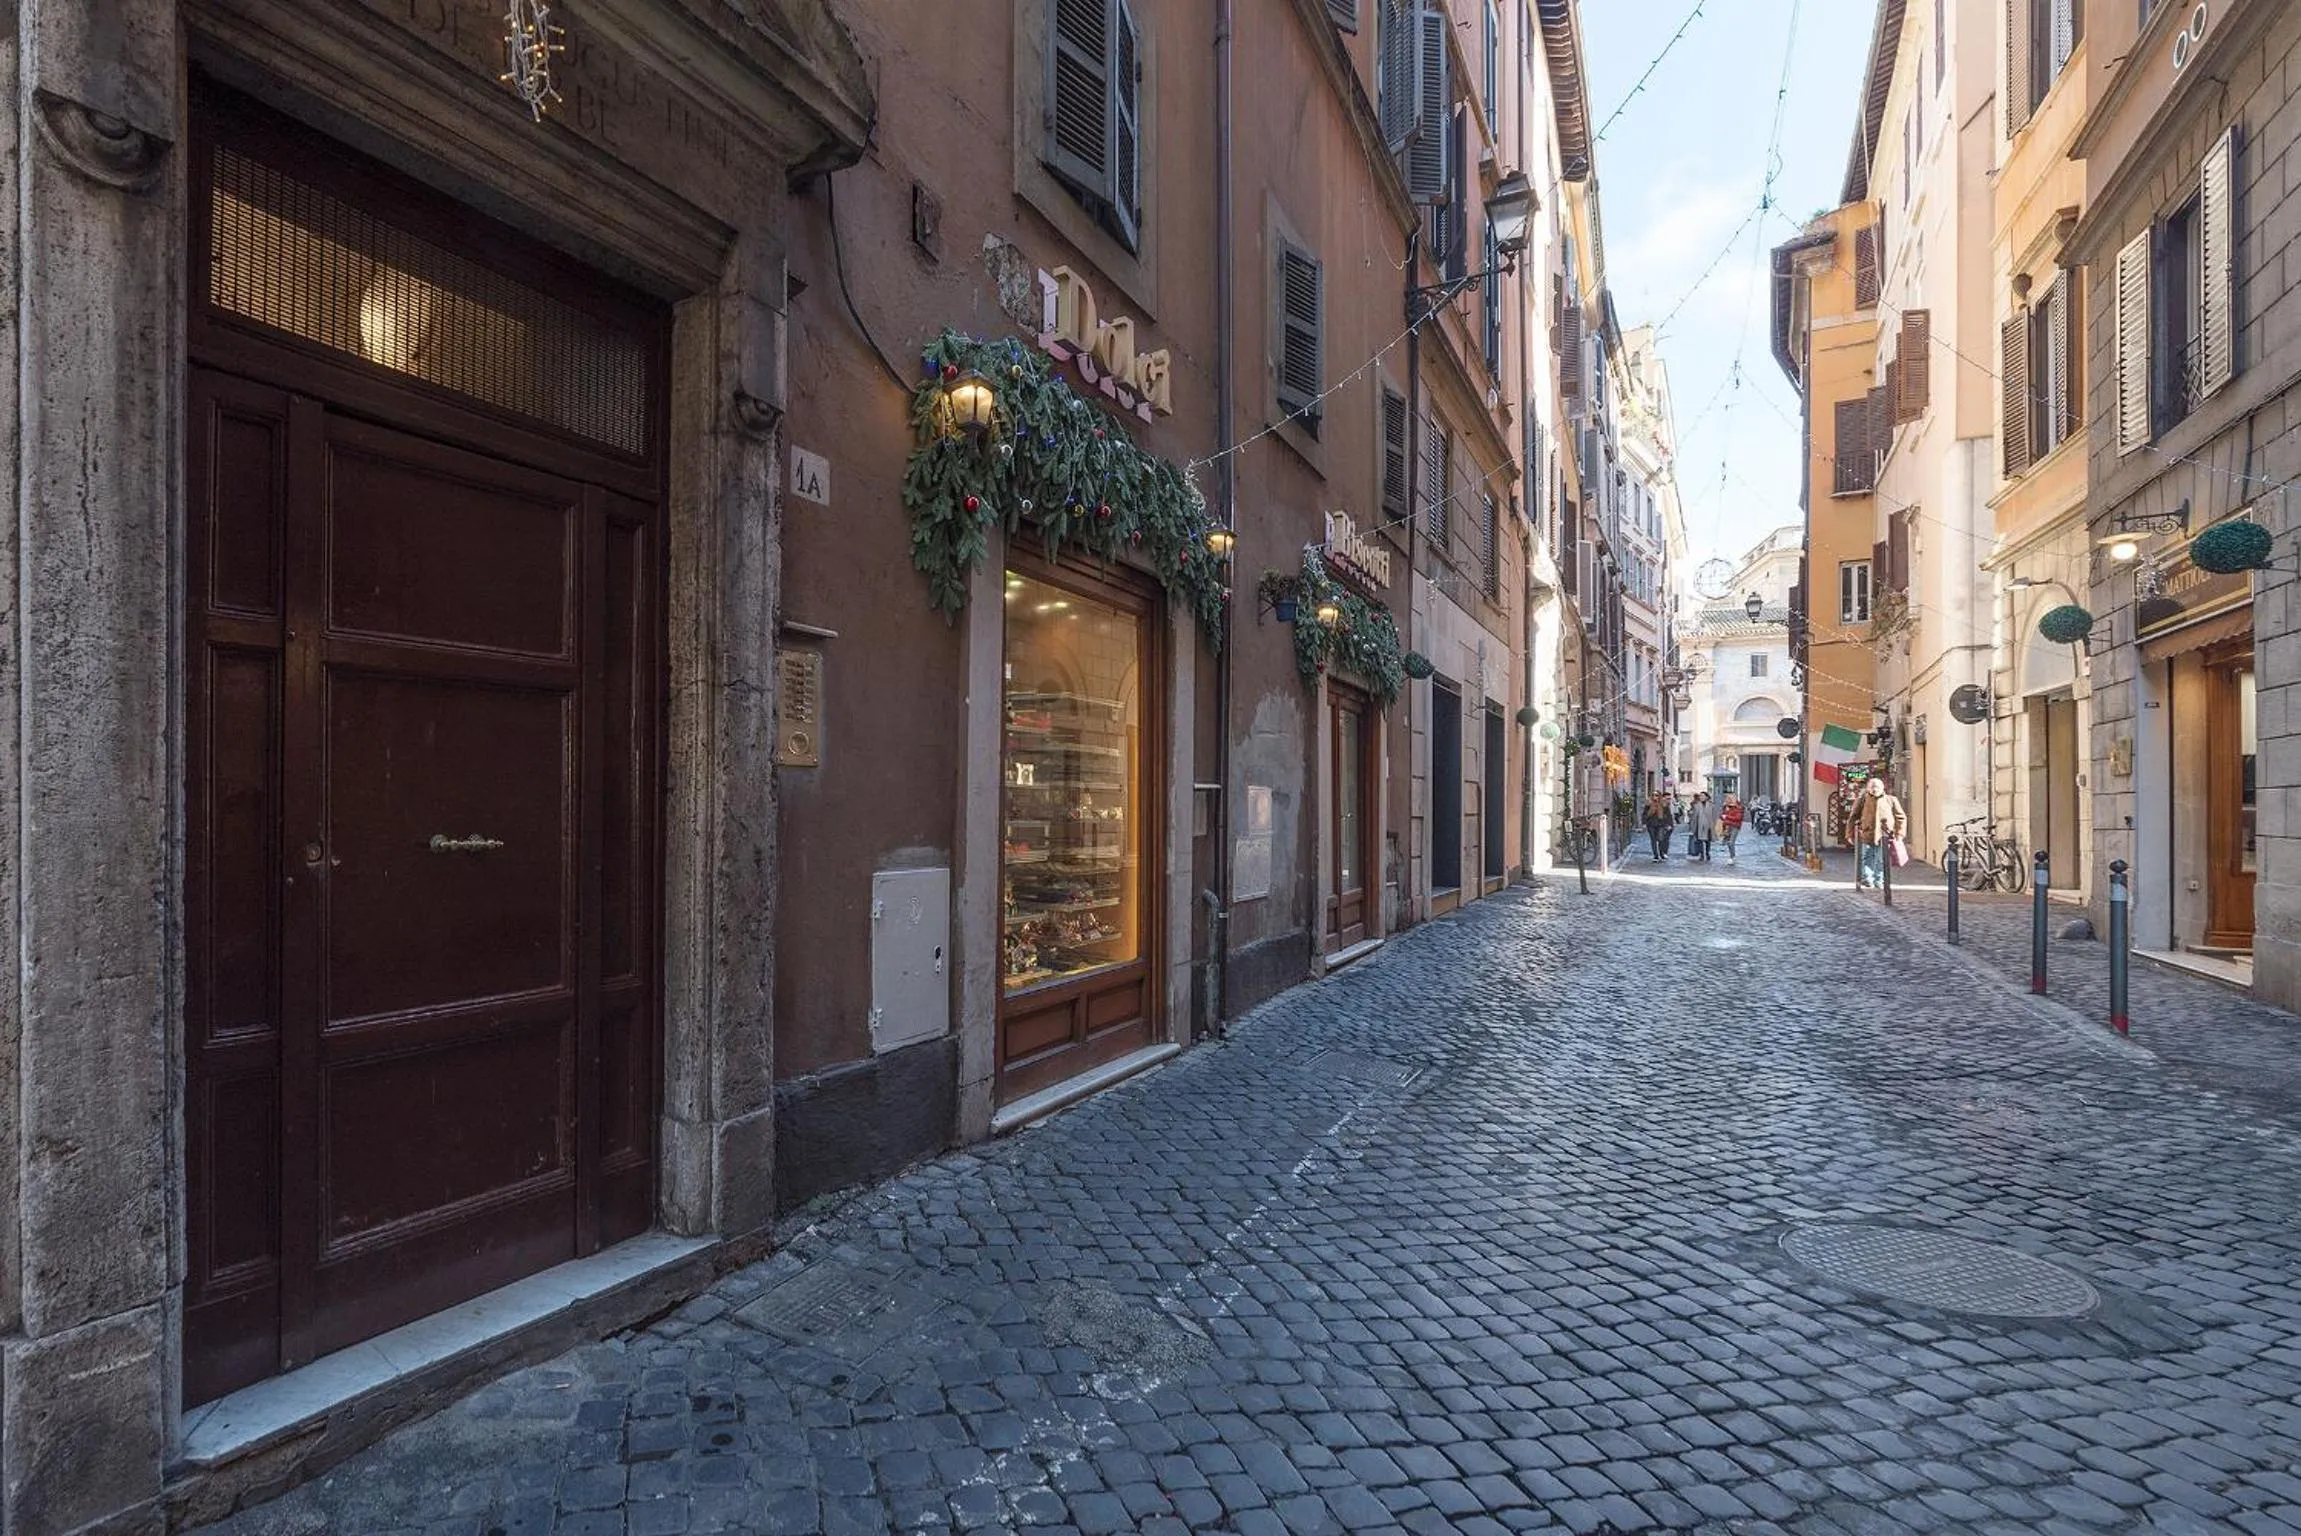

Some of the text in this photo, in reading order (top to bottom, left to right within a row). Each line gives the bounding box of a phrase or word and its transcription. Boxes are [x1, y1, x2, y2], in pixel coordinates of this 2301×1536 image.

[1044, 264, 1173, 421] Dolci
[795, 456, 822, 499] 1A
[1328, 509, 1391, 590] Biscotti
